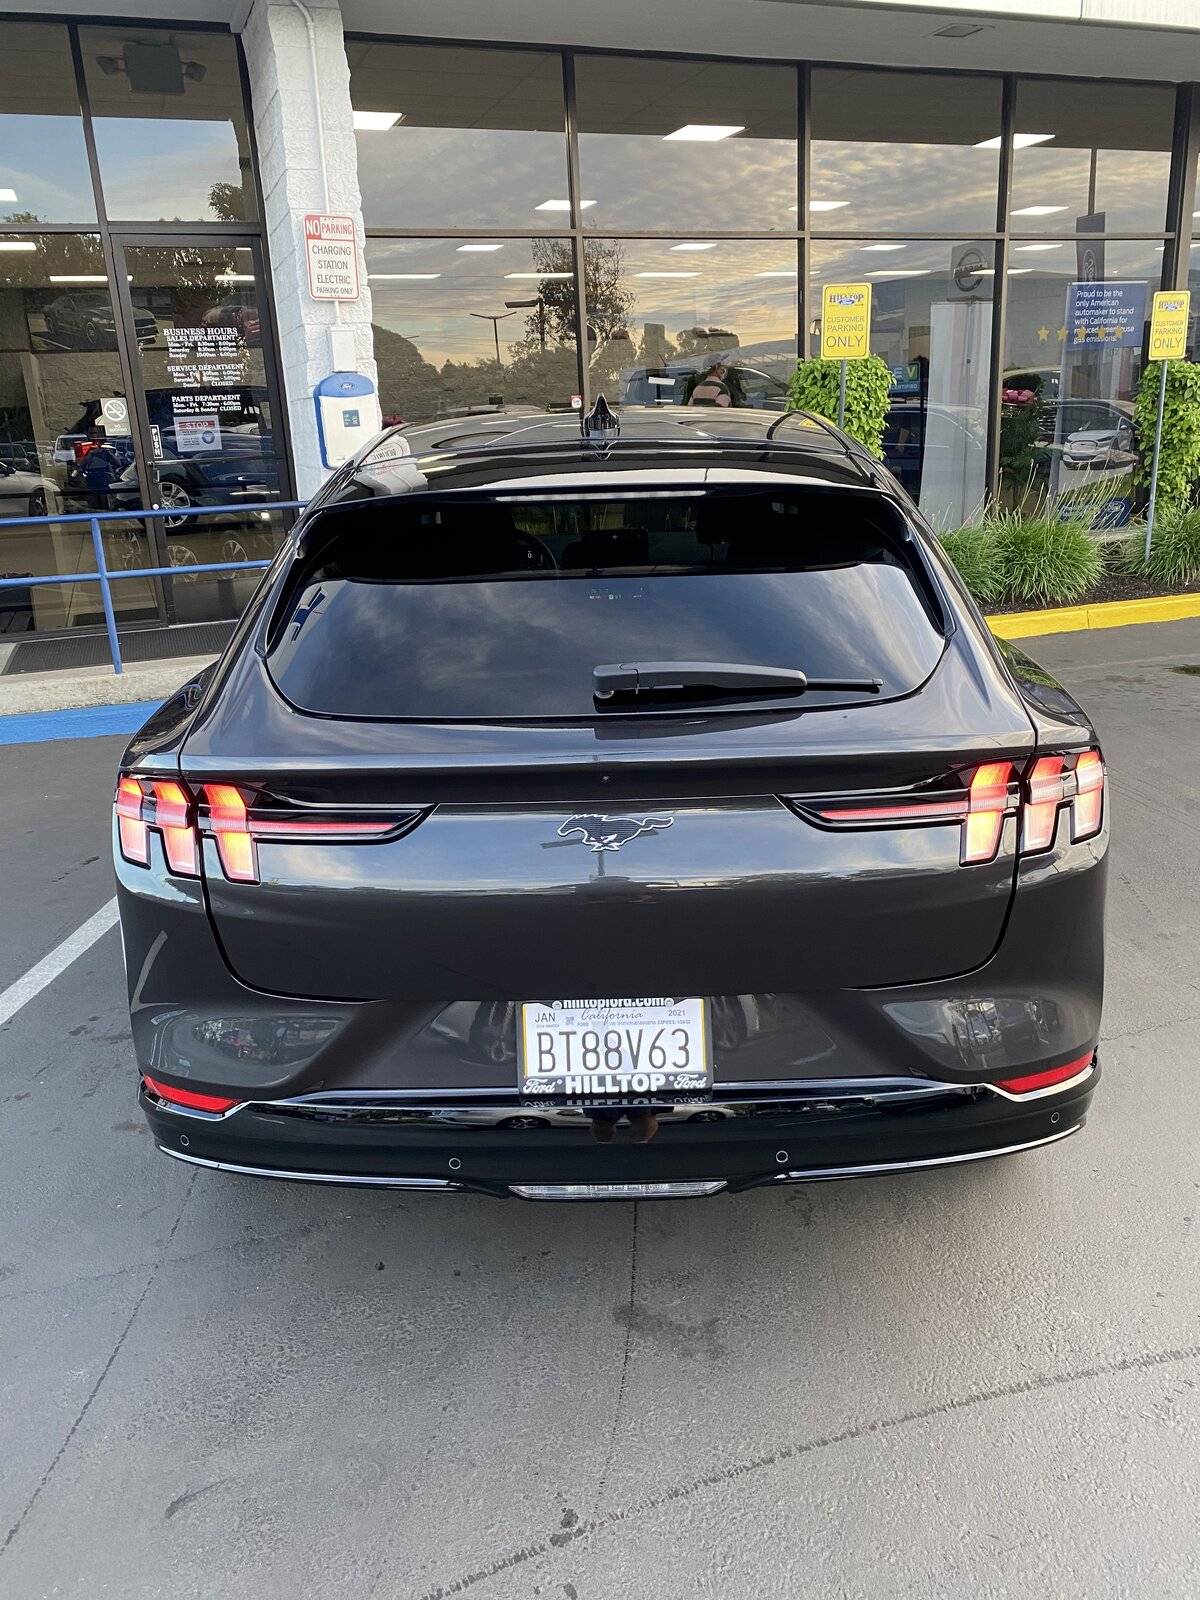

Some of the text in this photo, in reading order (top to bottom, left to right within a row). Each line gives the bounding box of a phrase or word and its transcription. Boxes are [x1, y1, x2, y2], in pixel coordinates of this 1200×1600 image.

[306, 219, 352, 236] NO PARKING
[312, 244, 352, 256] CHARGING
[318, 259, 348, 270] STATION
[317, 274, 351, 285] ELECTRIC
[317, 287, 354, 295] PARKING ONLY
[1076, 289, 1096, 298] Proud
[1113, 289, 1123, 297] the
[1075, 300, 1090, 308] only
[1116, 307, 1135, 315] stand
[1089, 317, 1118, 325] California
[163, 327, 238, 336] BUSINESS HOURS
[827, 324, 864, 332] PARKING
[1074, 326, 1099, 334] ruced
[826, 335, 864, 348] ONLY
[1153, 337, 1183, 349] ONLY
[198, 363, 244, 371] DEPARTMENT
[194, 394, 241, 402] DEPARTMENT
[185, 421, 209, 430] STOP
[151, 428, 161, 456] PUSH
[535, 1011, 556, 1023] JAN
[581, 1006, 645, 1026] California
[667, 1009, 687, 1017] 2021
[536, 1028, 690, 1073] BT88V63
[523, 1073, 707, 1095] Ford HILLTOP Ford
